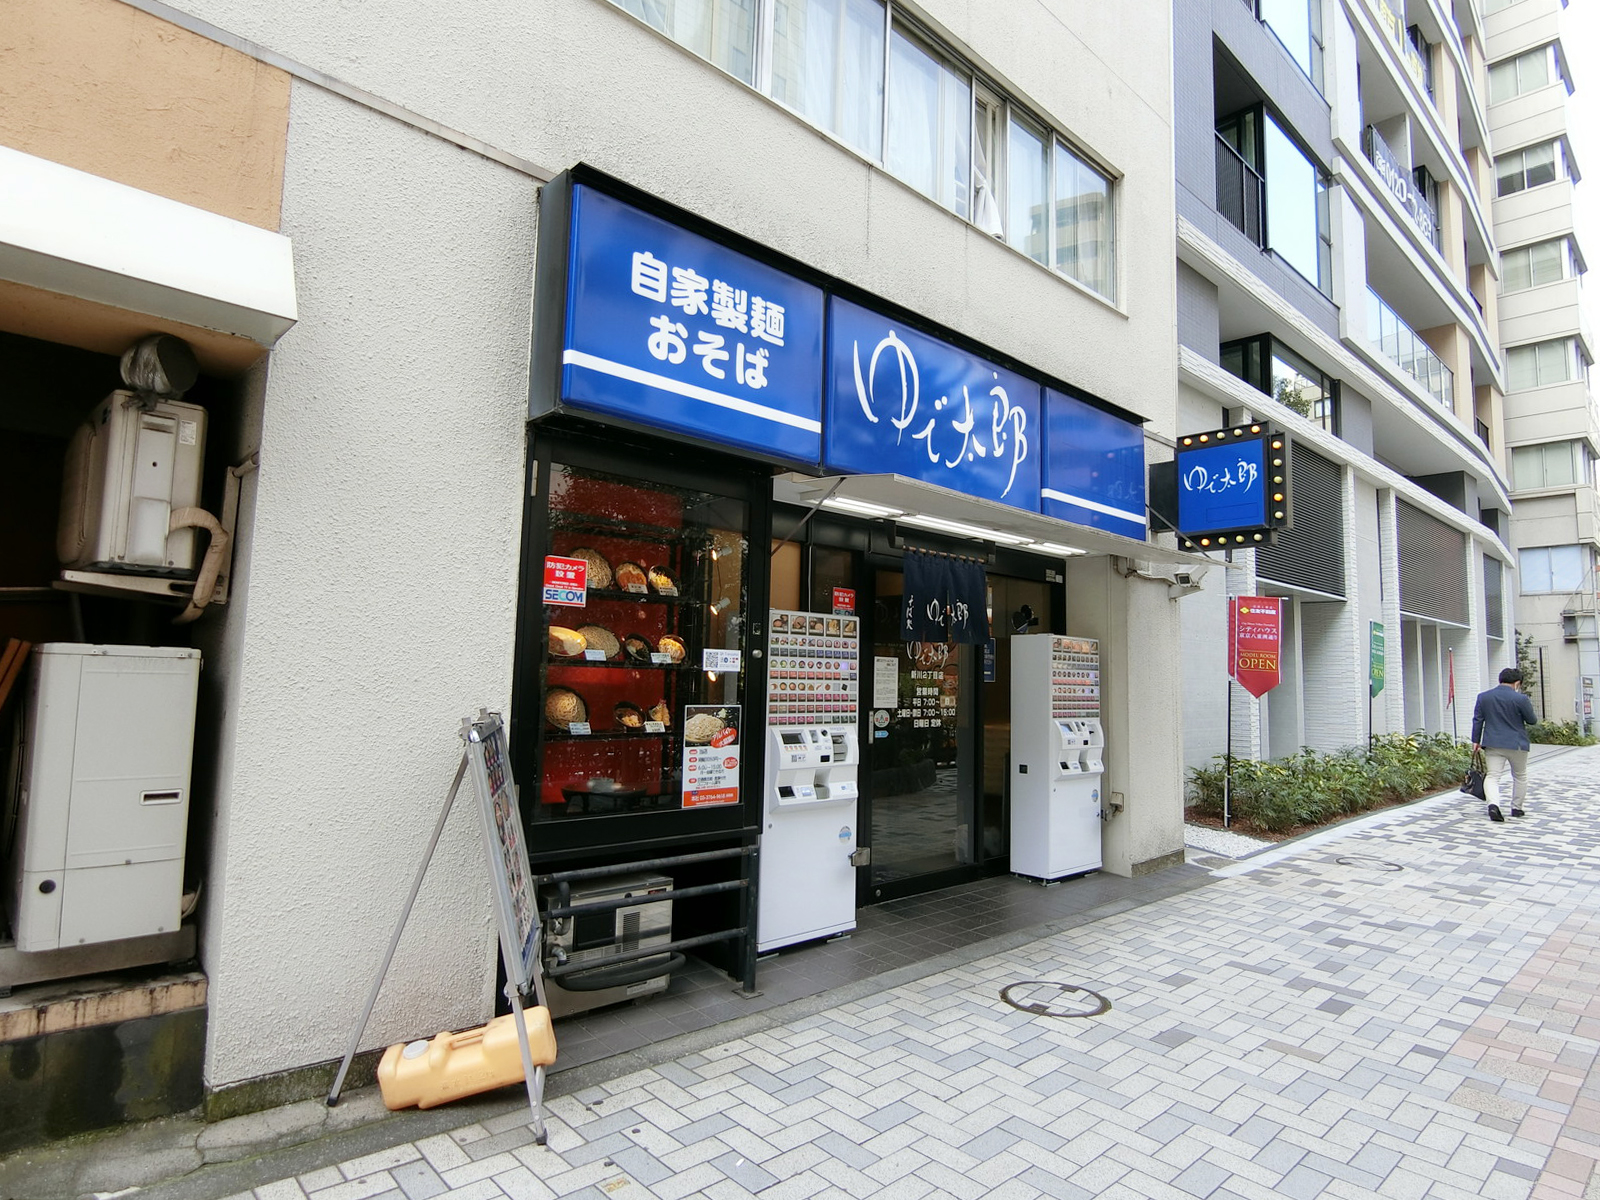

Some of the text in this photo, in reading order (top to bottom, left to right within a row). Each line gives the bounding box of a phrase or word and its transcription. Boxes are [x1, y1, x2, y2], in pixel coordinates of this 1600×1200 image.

[631, 251, 785, 347] 自家製麺
[648, 315, 769, 390] おそば
[853, 329, 1028, 499] ゆで太郎
[1183, 458, 1258, 494] ゆで太郎
[546, 561, 585, 572] 防犯カメラ
[545, 589, 583, 602] SECOM
[1239, 626, 1278, 634] シティハウス
[1239, 658, 1276, 669] OPEN
[916, 687, 939, 696] 営業時間
